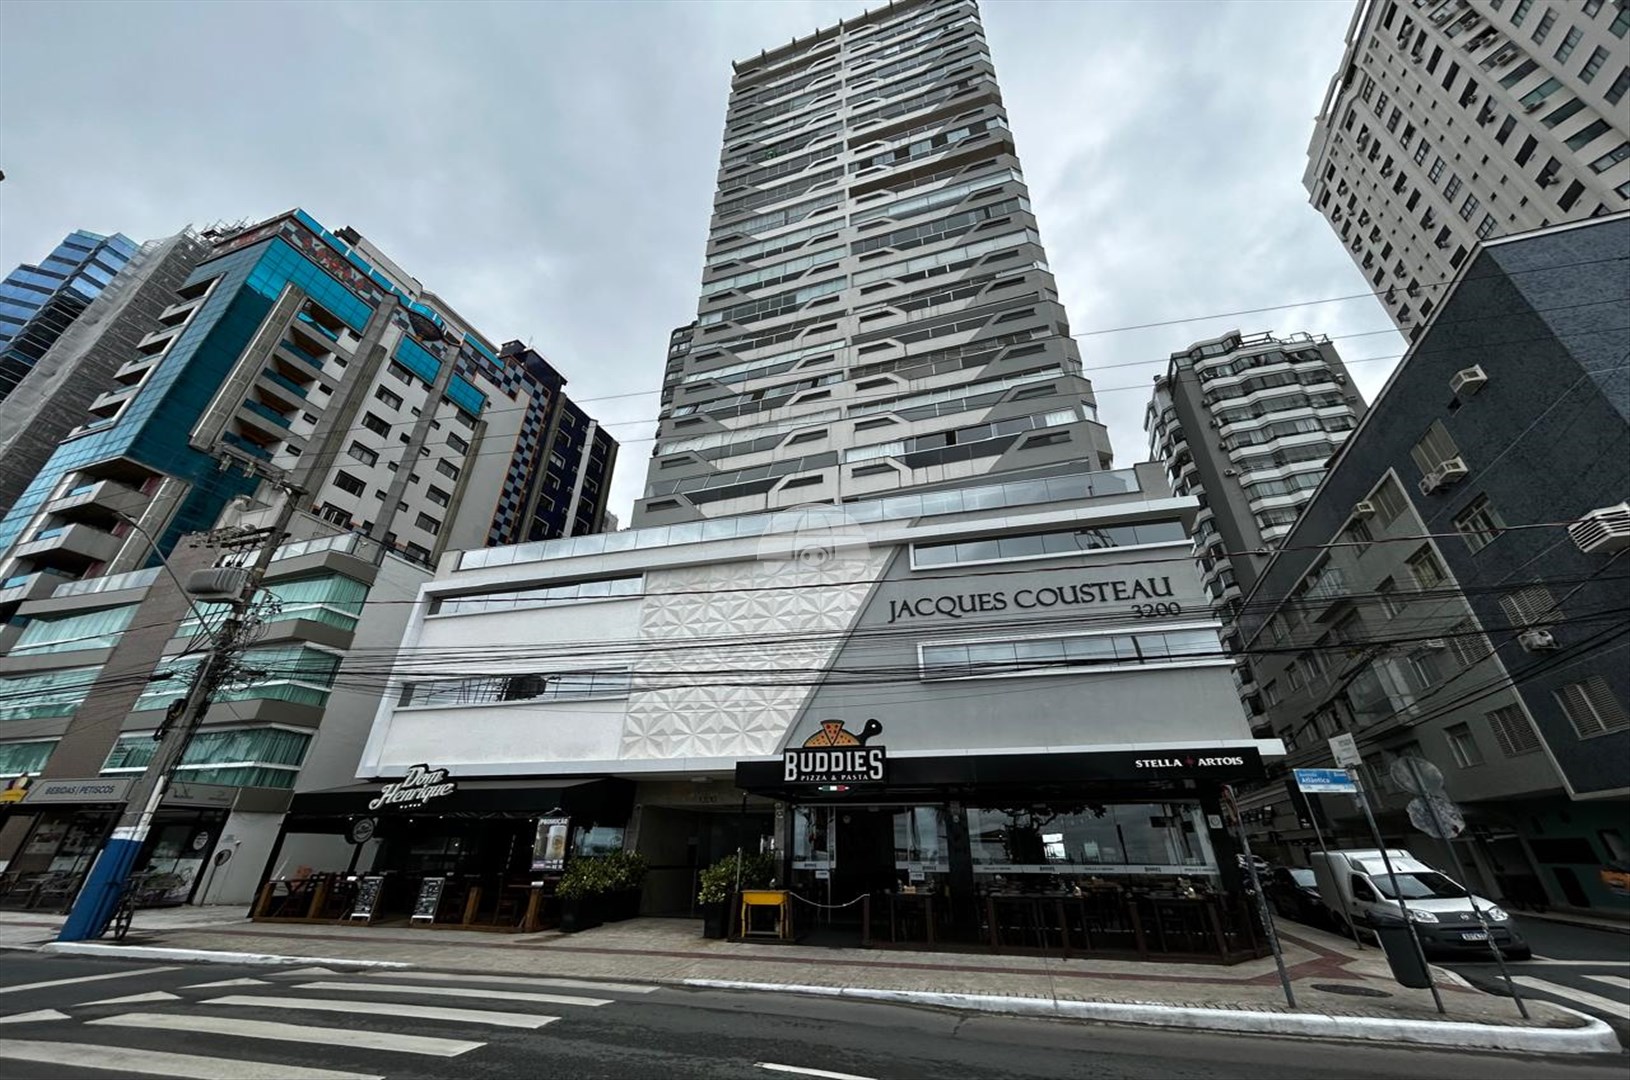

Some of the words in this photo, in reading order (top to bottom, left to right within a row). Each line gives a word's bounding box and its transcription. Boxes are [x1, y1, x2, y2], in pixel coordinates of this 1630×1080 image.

[887, 591, 1007, 623] JACQUES
[1014, 577, 1174, 608] COUSTEAU
[1131, 602, 1181, 619] 3200
[784, 750, 883, 781] BUDDIES
[1135, 758, 1182, 768] STELLA
[1198, 756, 1243, 766] ARTOIS
[402, 766, 444, 788] Dom
[79, 785, 115, 794] PETISCOS
[369, 780, 454, 810] Henrique
